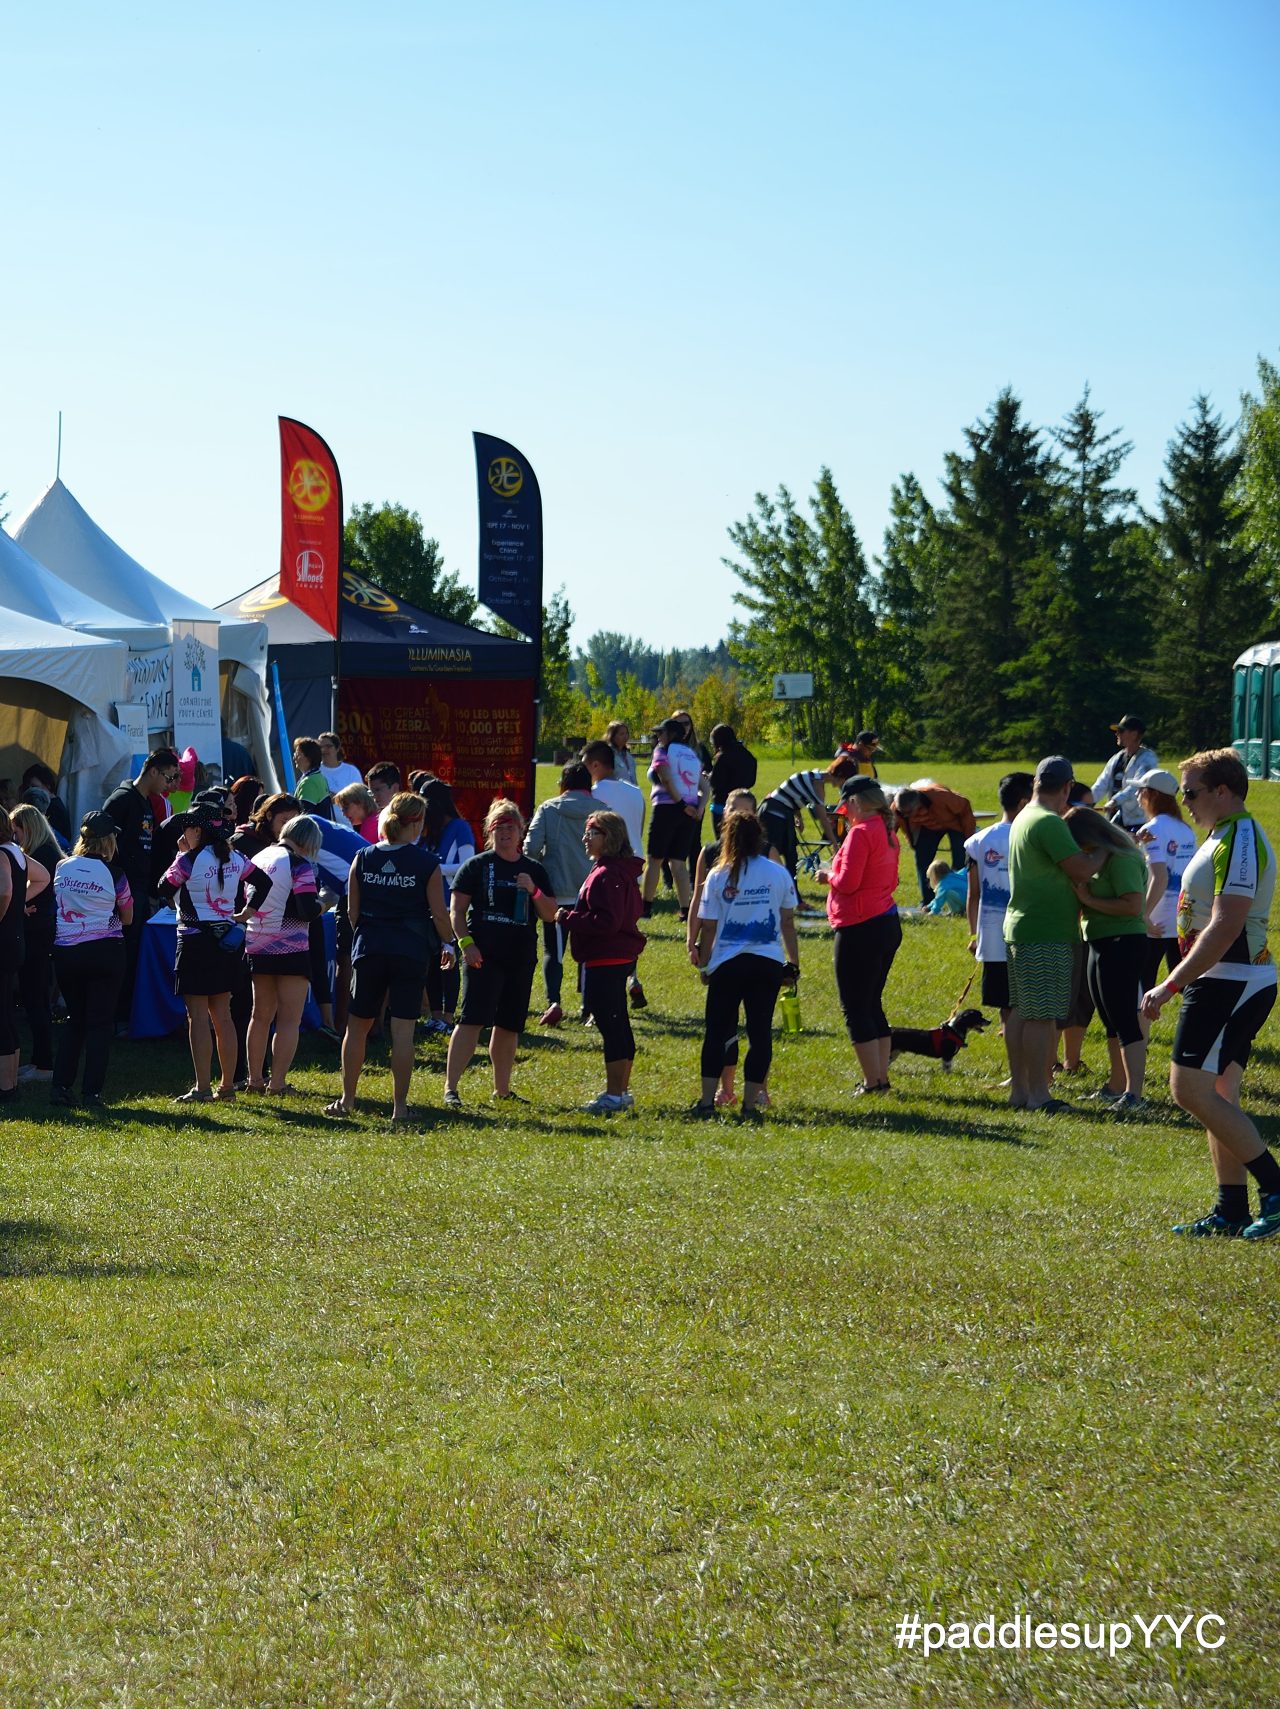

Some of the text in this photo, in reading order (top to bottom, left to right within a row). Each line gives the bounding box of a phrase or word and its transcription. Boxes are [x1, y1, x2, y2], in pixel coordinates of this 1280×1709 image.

[407, 647, 472, 662] ILLUMINASIA
[472, 708, 489, 720] LED
[492, 708, 520, 720] BULBS
[395, 719, 432, 733] ZEBRA
[456, 721, 521, 735] 10,000 FEET
[60, 876, 104, 893] Sistership
[743, 886, 770, 896] nexen
